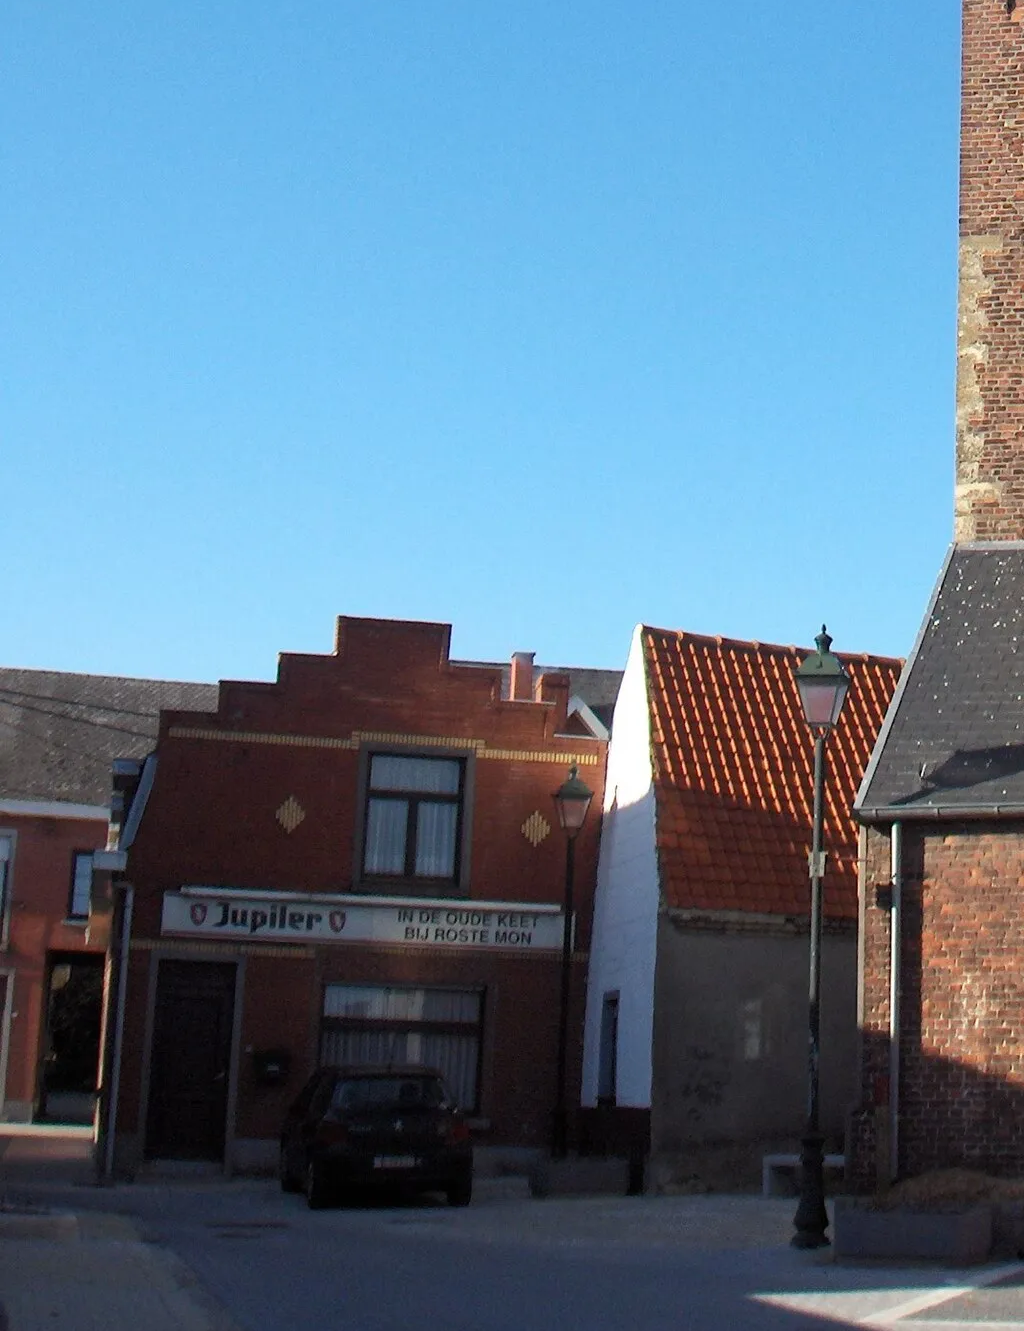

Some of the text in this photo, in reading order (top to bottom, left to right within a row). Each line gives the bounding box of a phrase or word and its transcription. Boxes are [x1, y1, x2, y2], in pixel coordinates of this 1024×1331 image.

[211, 901, 323, 933] Jupiler
[397, 910, 539, 928] IN DE OUDE KEET
[404, 926, 533, 945] BIJ ROSTE MON
